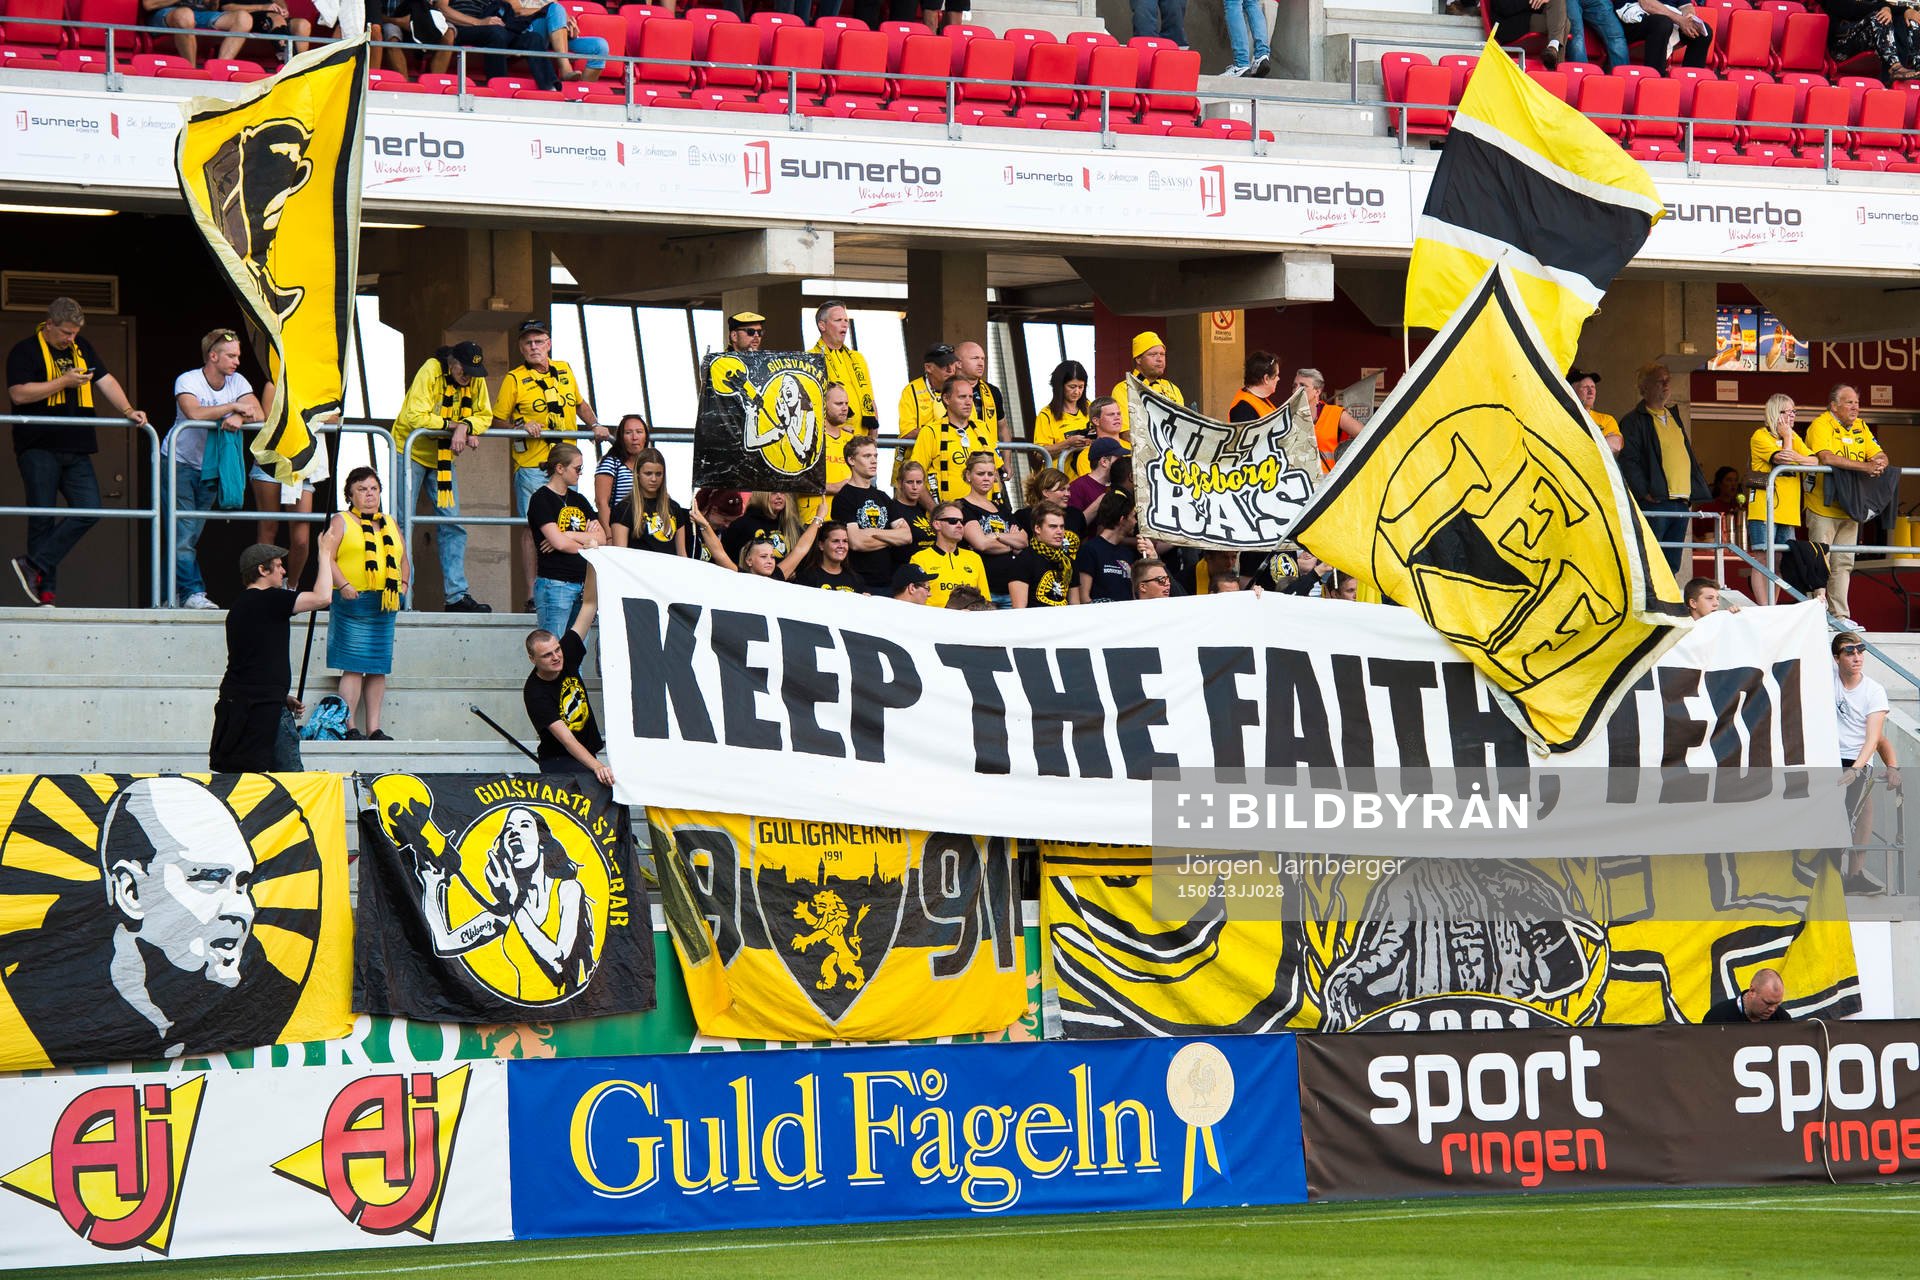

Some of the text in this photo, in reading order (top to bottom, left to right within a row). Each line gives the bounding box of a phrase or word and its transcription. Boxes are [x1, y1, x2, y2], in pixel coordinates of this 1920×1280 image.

[31, 116, 99, 129] sunnerbo
[544, 144, 607, 157] sunnerbo
[374, 159, 421, 174] Windows
[437, 161, 467, 175] Doors
[780, 158, 942, 185] sunnerbo
[1016, 170, 1073, 183] sunnerbo
[858, 185, 901, 200] Windows
[916, 186, 944, 200] Doors
[1234, 181, 1384, 207] sunnerbo
[1306, 208, 1348, 222] Windows
[1361, 208, 1387, 221] Doors
[1661, 201, 1802, 226] sunnerbo
[1867, 211, 1919, 221] sunnerbo
[1728, 226, 1767, 240] Windows
[1779, 226, 1803, 240] Doors
[621, 597, 1811, 821] KEEP THE FAITH, TED!
[474, 779, 593, 822] GULSVARTA
[758, 820, 903, 846] GULIGANERNA
[823, 850, 843, 862] 1991
[1367, 1035, 1604, 1144] sport
[569, 1073, 827, 1199] Guld
[843, 1062, 1162, 1213] Fågeln
